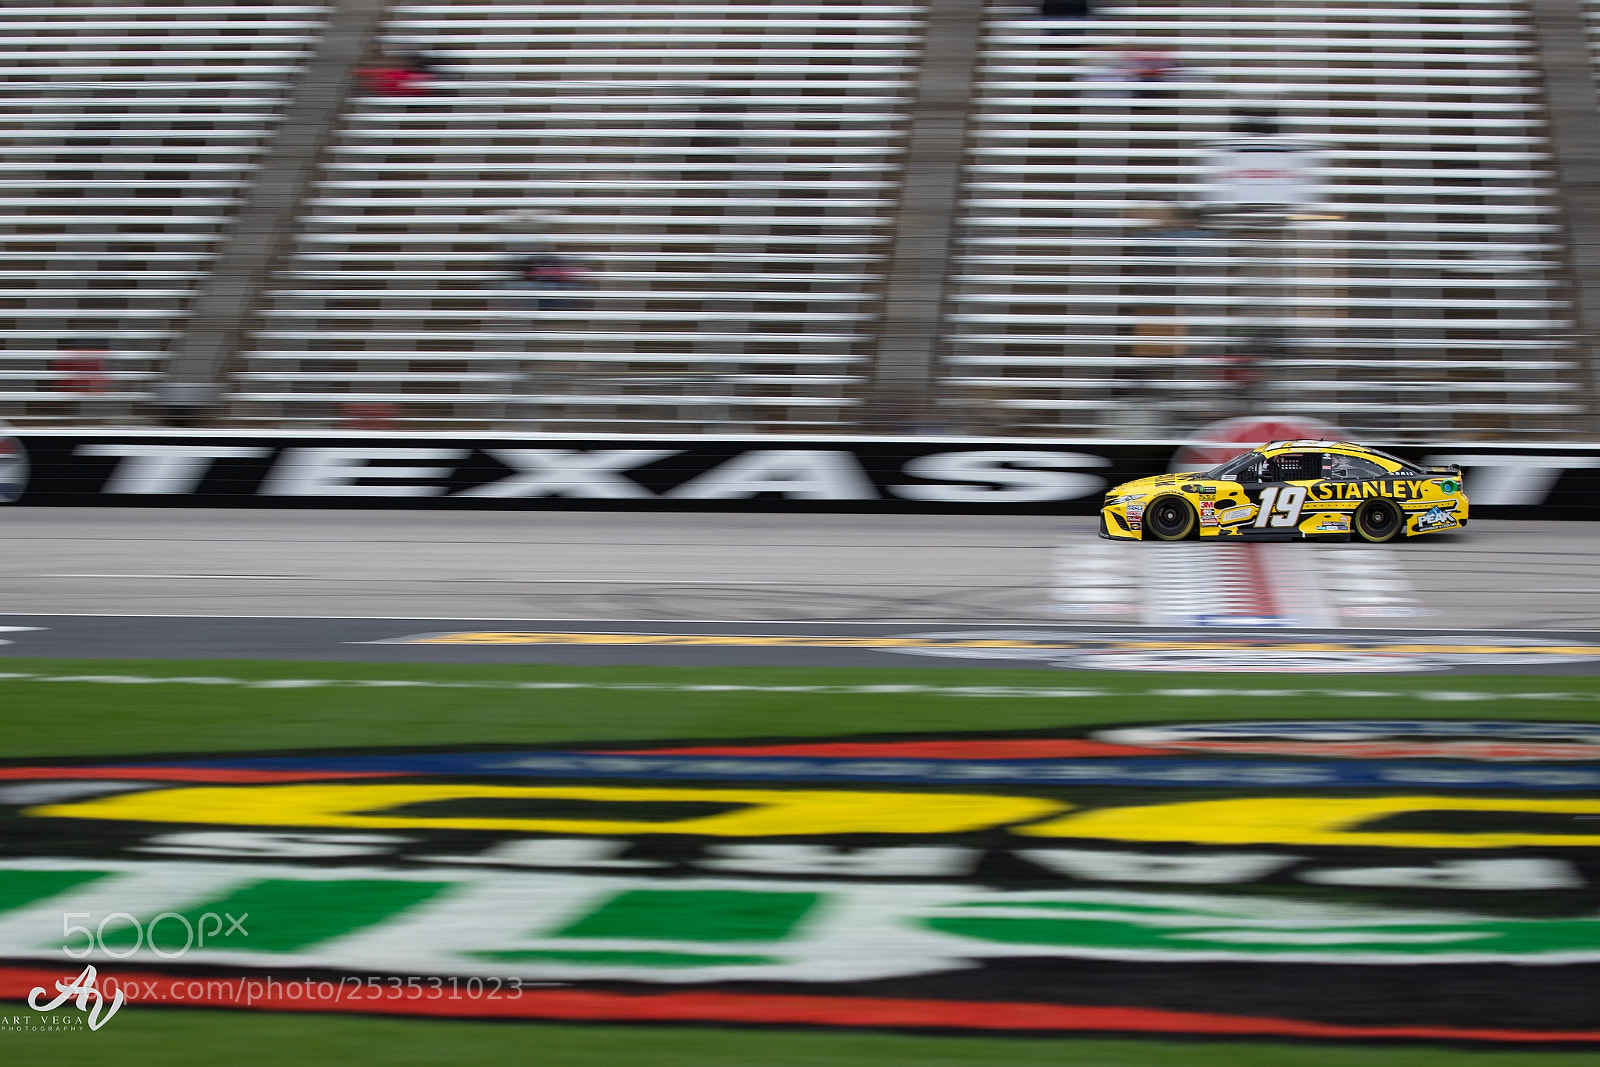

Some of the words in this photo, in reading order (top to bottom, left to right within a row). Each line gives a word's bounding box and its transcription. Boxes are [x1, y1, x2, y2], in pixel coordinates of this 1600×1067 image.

[73, 444, 1113, 502] TEXAS
[1319, 481, 1423, 500] STANLEY
[1200, 501, 1214, 509] 3M
[1253, 487, 1305, 527] 19
[1417, 510, 1456, 528] PEAK
